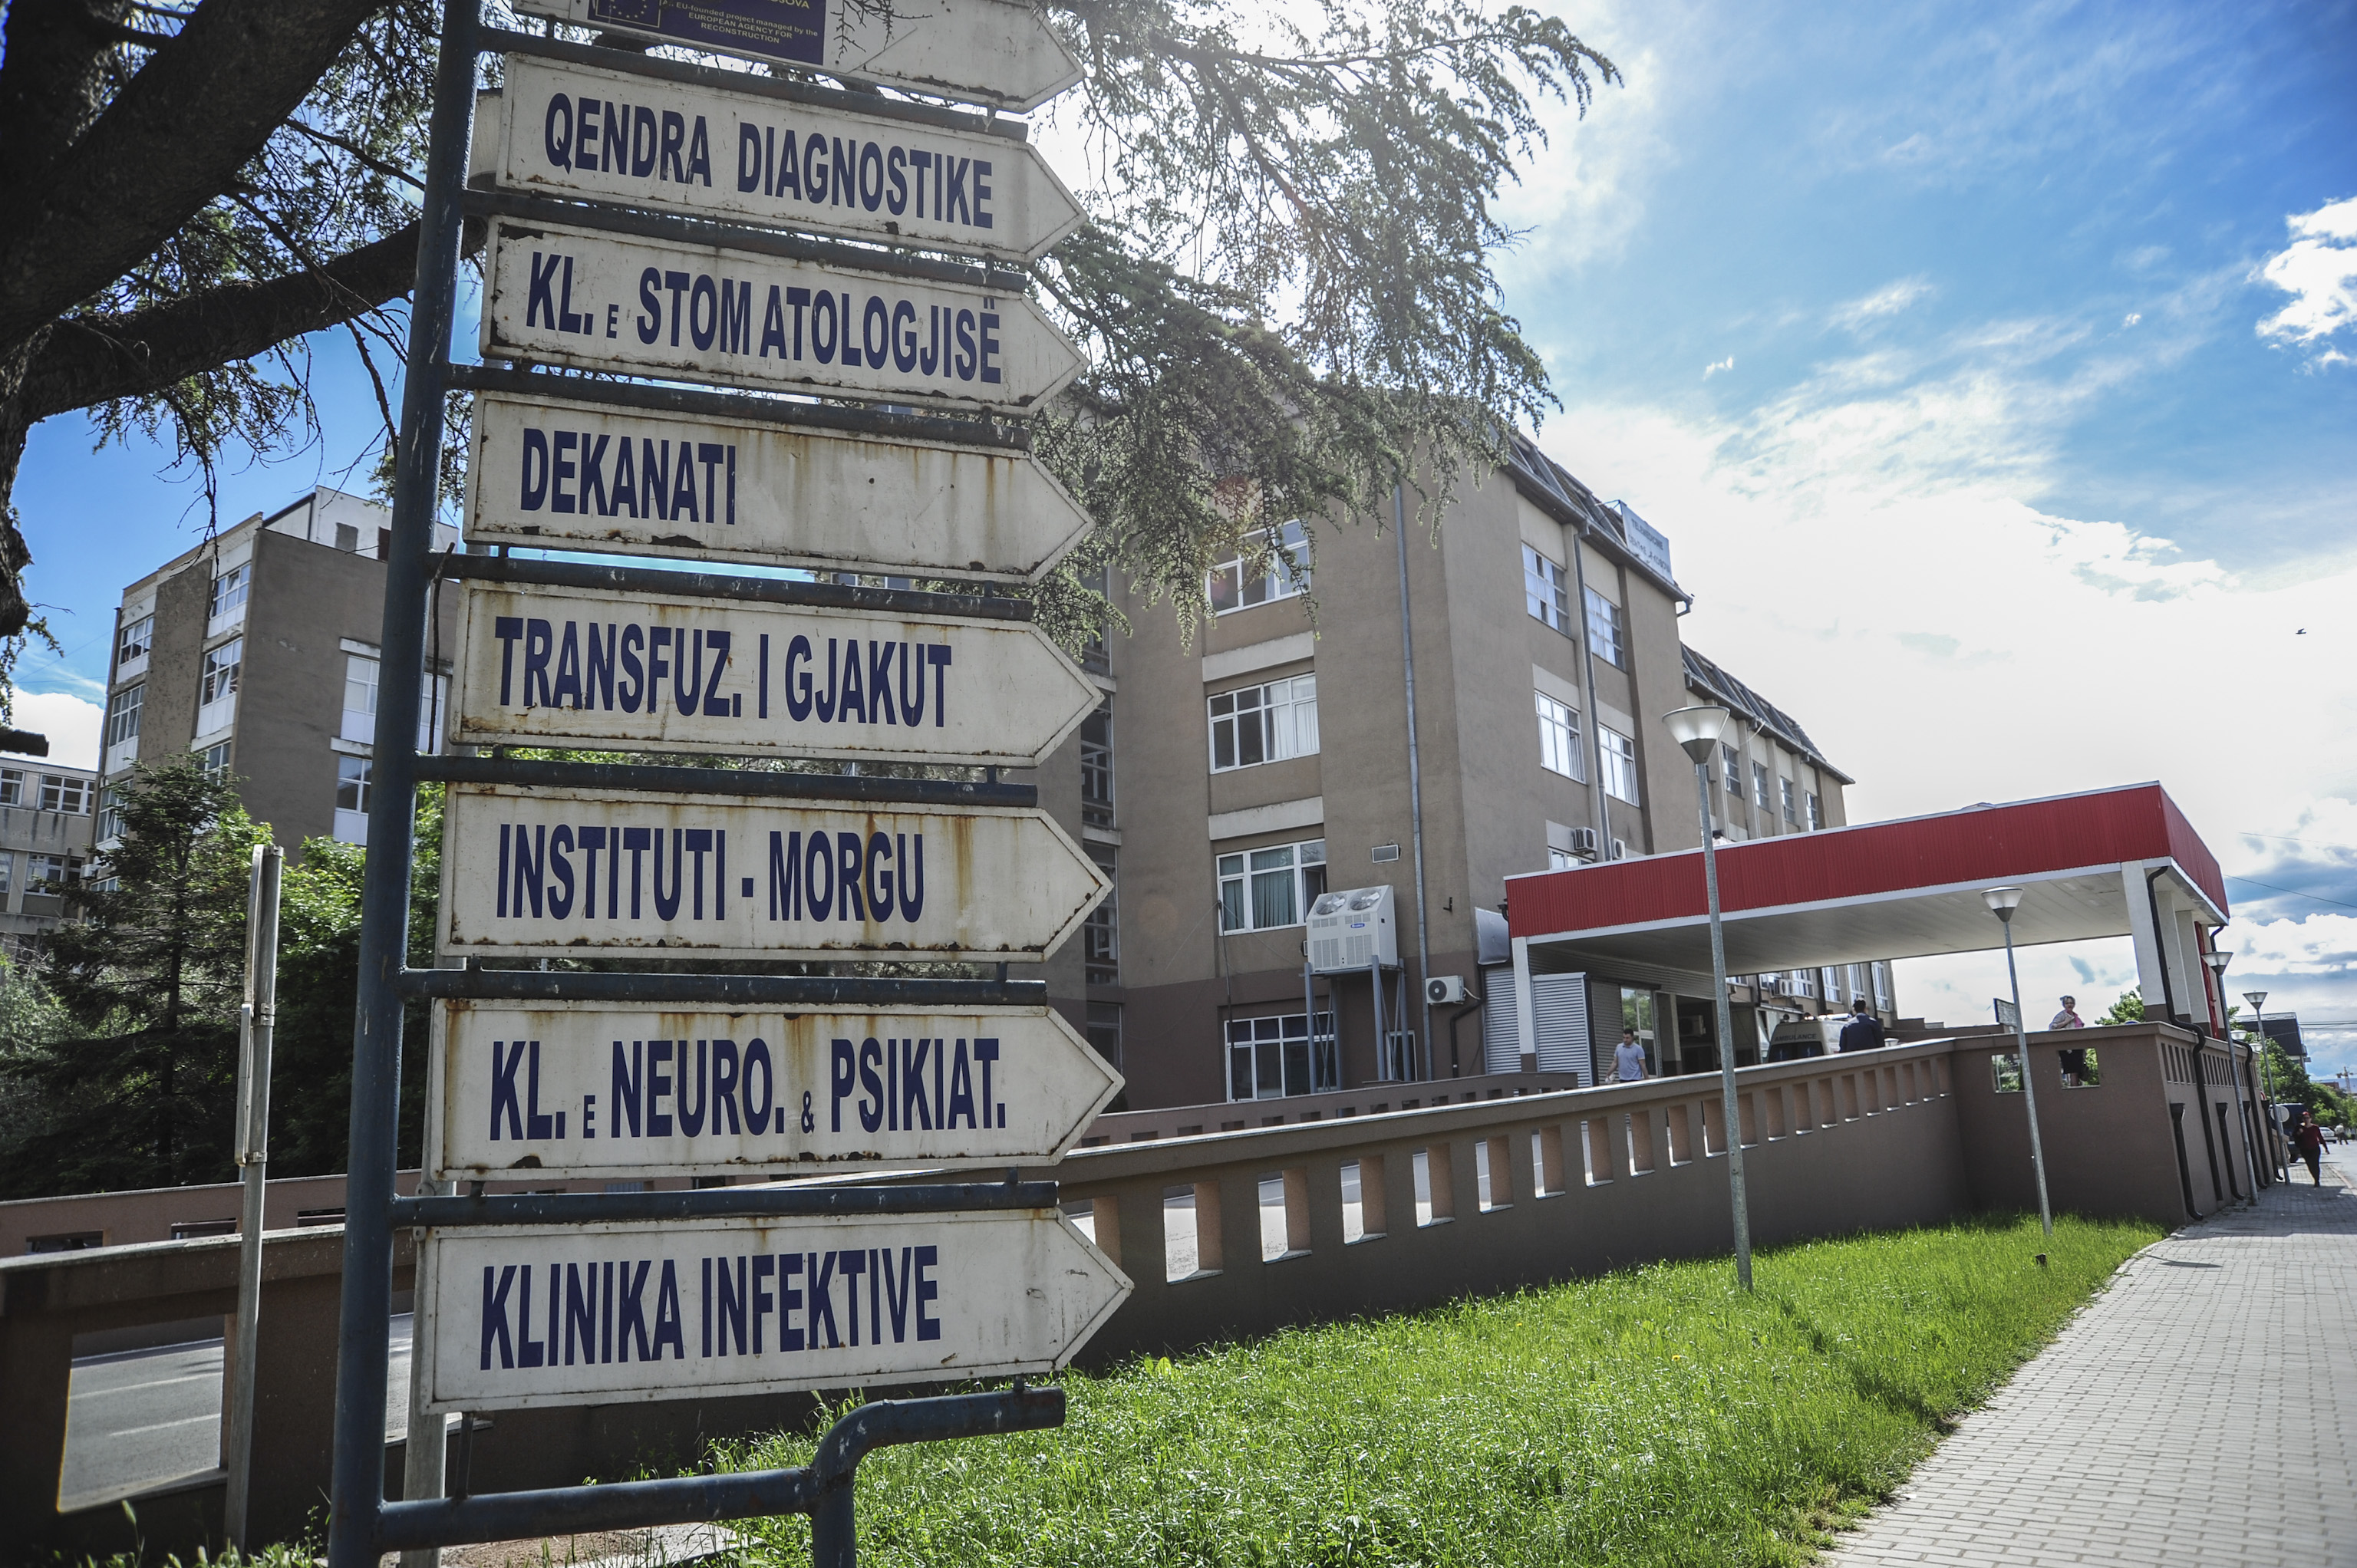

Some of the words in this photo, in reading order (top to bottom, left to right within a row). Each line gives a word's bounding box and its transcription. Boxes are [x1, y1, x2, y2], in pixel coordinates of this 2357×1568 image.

[676, 2, 724, 17] EU-founded
[726, 12, 754, 23] project
[756, 19, 793, 31] managed
[794, 26, 804, 35] by
[806, 28, 818, 37] the
[688, 12, 736, 27] EUROPEAN
[737, 22, 773, 35] AGENCY
[775, 29, 793, 38] FOR
[701, 22, 780, 44] RECONSTRUCTION
[545, 93, 712, 187] QENDRA
[737, 122, 993, 229] DIAGNOSTIKE
[526, 251, 595, 335] KL.
[606, 304, 618, 339] E
[520, 428, 736, 525] DEKANATI
[496, 617, 742, 718] TRANSFUZ.
[759, 634, 768, 719] I
[786, 634, 952, 728] GJAKUT
[496, 824, 726, 921] INSTITUTI
[770, 831, 925, 923] MORGU
[1775, 1033, 1816, 1042] AMBULANCE
[490, 1040, 566, 1141] KL.
[583, 1095, 596, 1138] E
[612, 1037, 785, 1138] NEURO.
[800, 1090, 815, 1134] &
[831, 1037, 1006, 1134] PSIKIAT.
[480, 1259, 686, 1370] KLINIKA
[701, 1245, 941, 1358] INFEKTIVE
